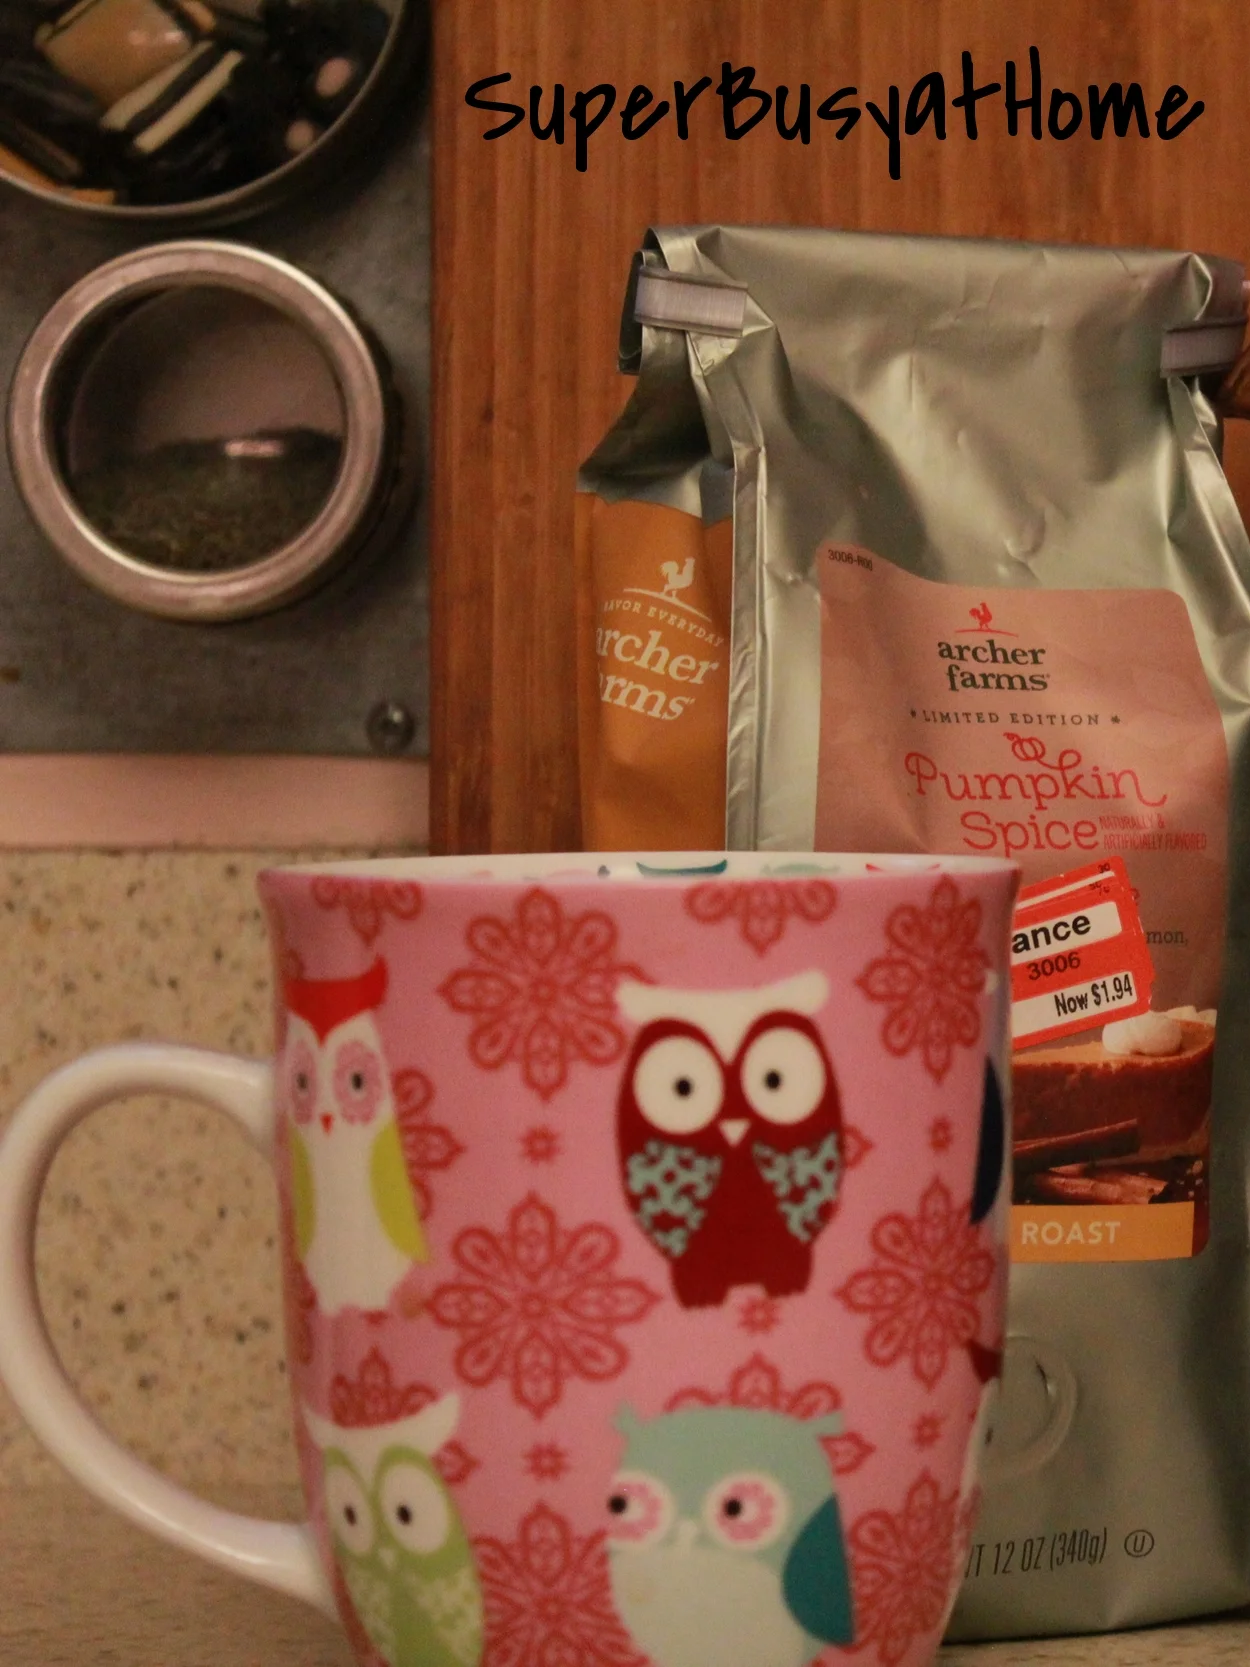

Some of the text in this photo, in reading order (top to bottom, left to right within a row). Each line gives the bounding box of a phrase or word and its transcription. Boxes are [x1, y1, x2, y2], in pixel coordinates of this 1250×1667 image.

[647, 606, 724, 647] EVERYDAY
[937, 639, 1046, 665] archer
[598, 673, 691, 721] rms
[946, 665, 1049, 692] farms
[923, 709, 1100, 726] LIMITED EDITION
[904, 748, 1168, 811] Pumpkin
[960, 811, 1100, 858] Spice
[1027, 952, 1081, 981] 3006
[1054, 974, 1133, 1017] Now $1.94
[1021, 1221, 1121, 1245] ROAST
[993, 1540, 1016, 1575] 12
[1020, 1537, 1046, 1572] OZ
[1050, 1527, 1108, 1572] (340g)
